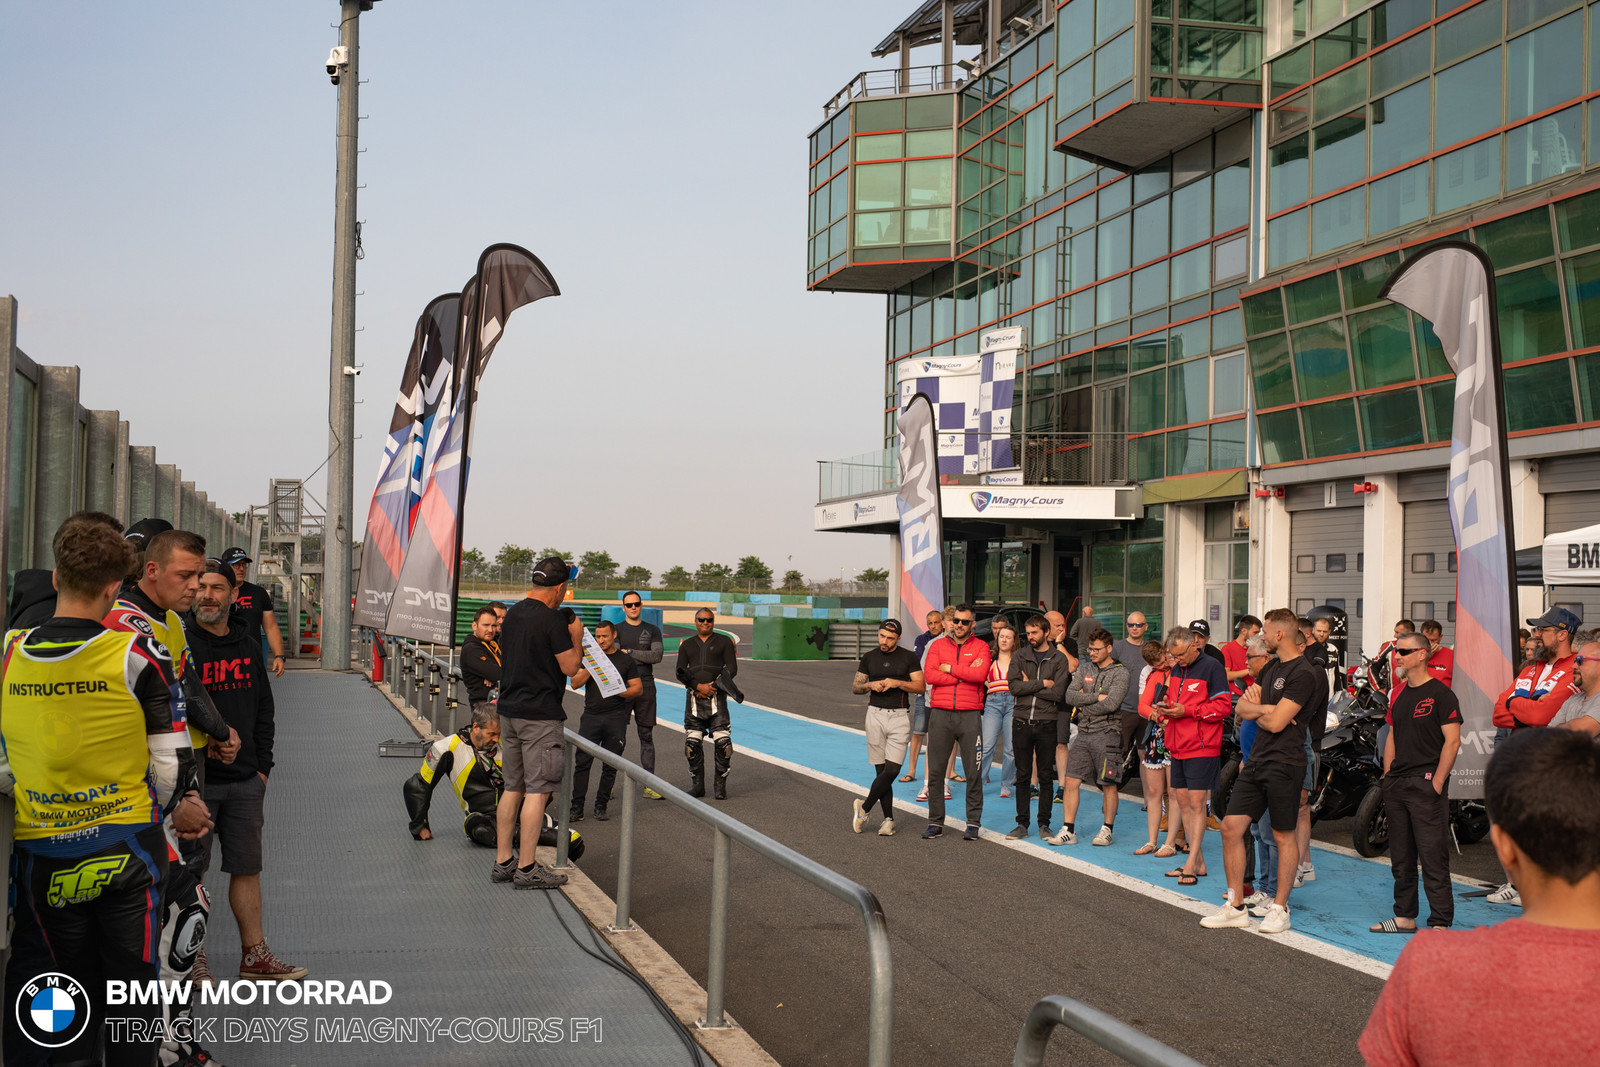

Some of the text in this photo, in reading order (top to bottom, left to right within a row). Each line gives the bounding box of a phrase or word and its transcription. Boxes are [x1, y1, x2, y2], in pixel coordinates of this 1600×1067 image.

[991, 496, 1065, 506] Magny-Cours
[9, 680, 109, 697] INSTRUCTEUR
[25, 783, 119, 805] TRACKDAYS
[39, 796, 129, 820] BMW MOTORRAD
